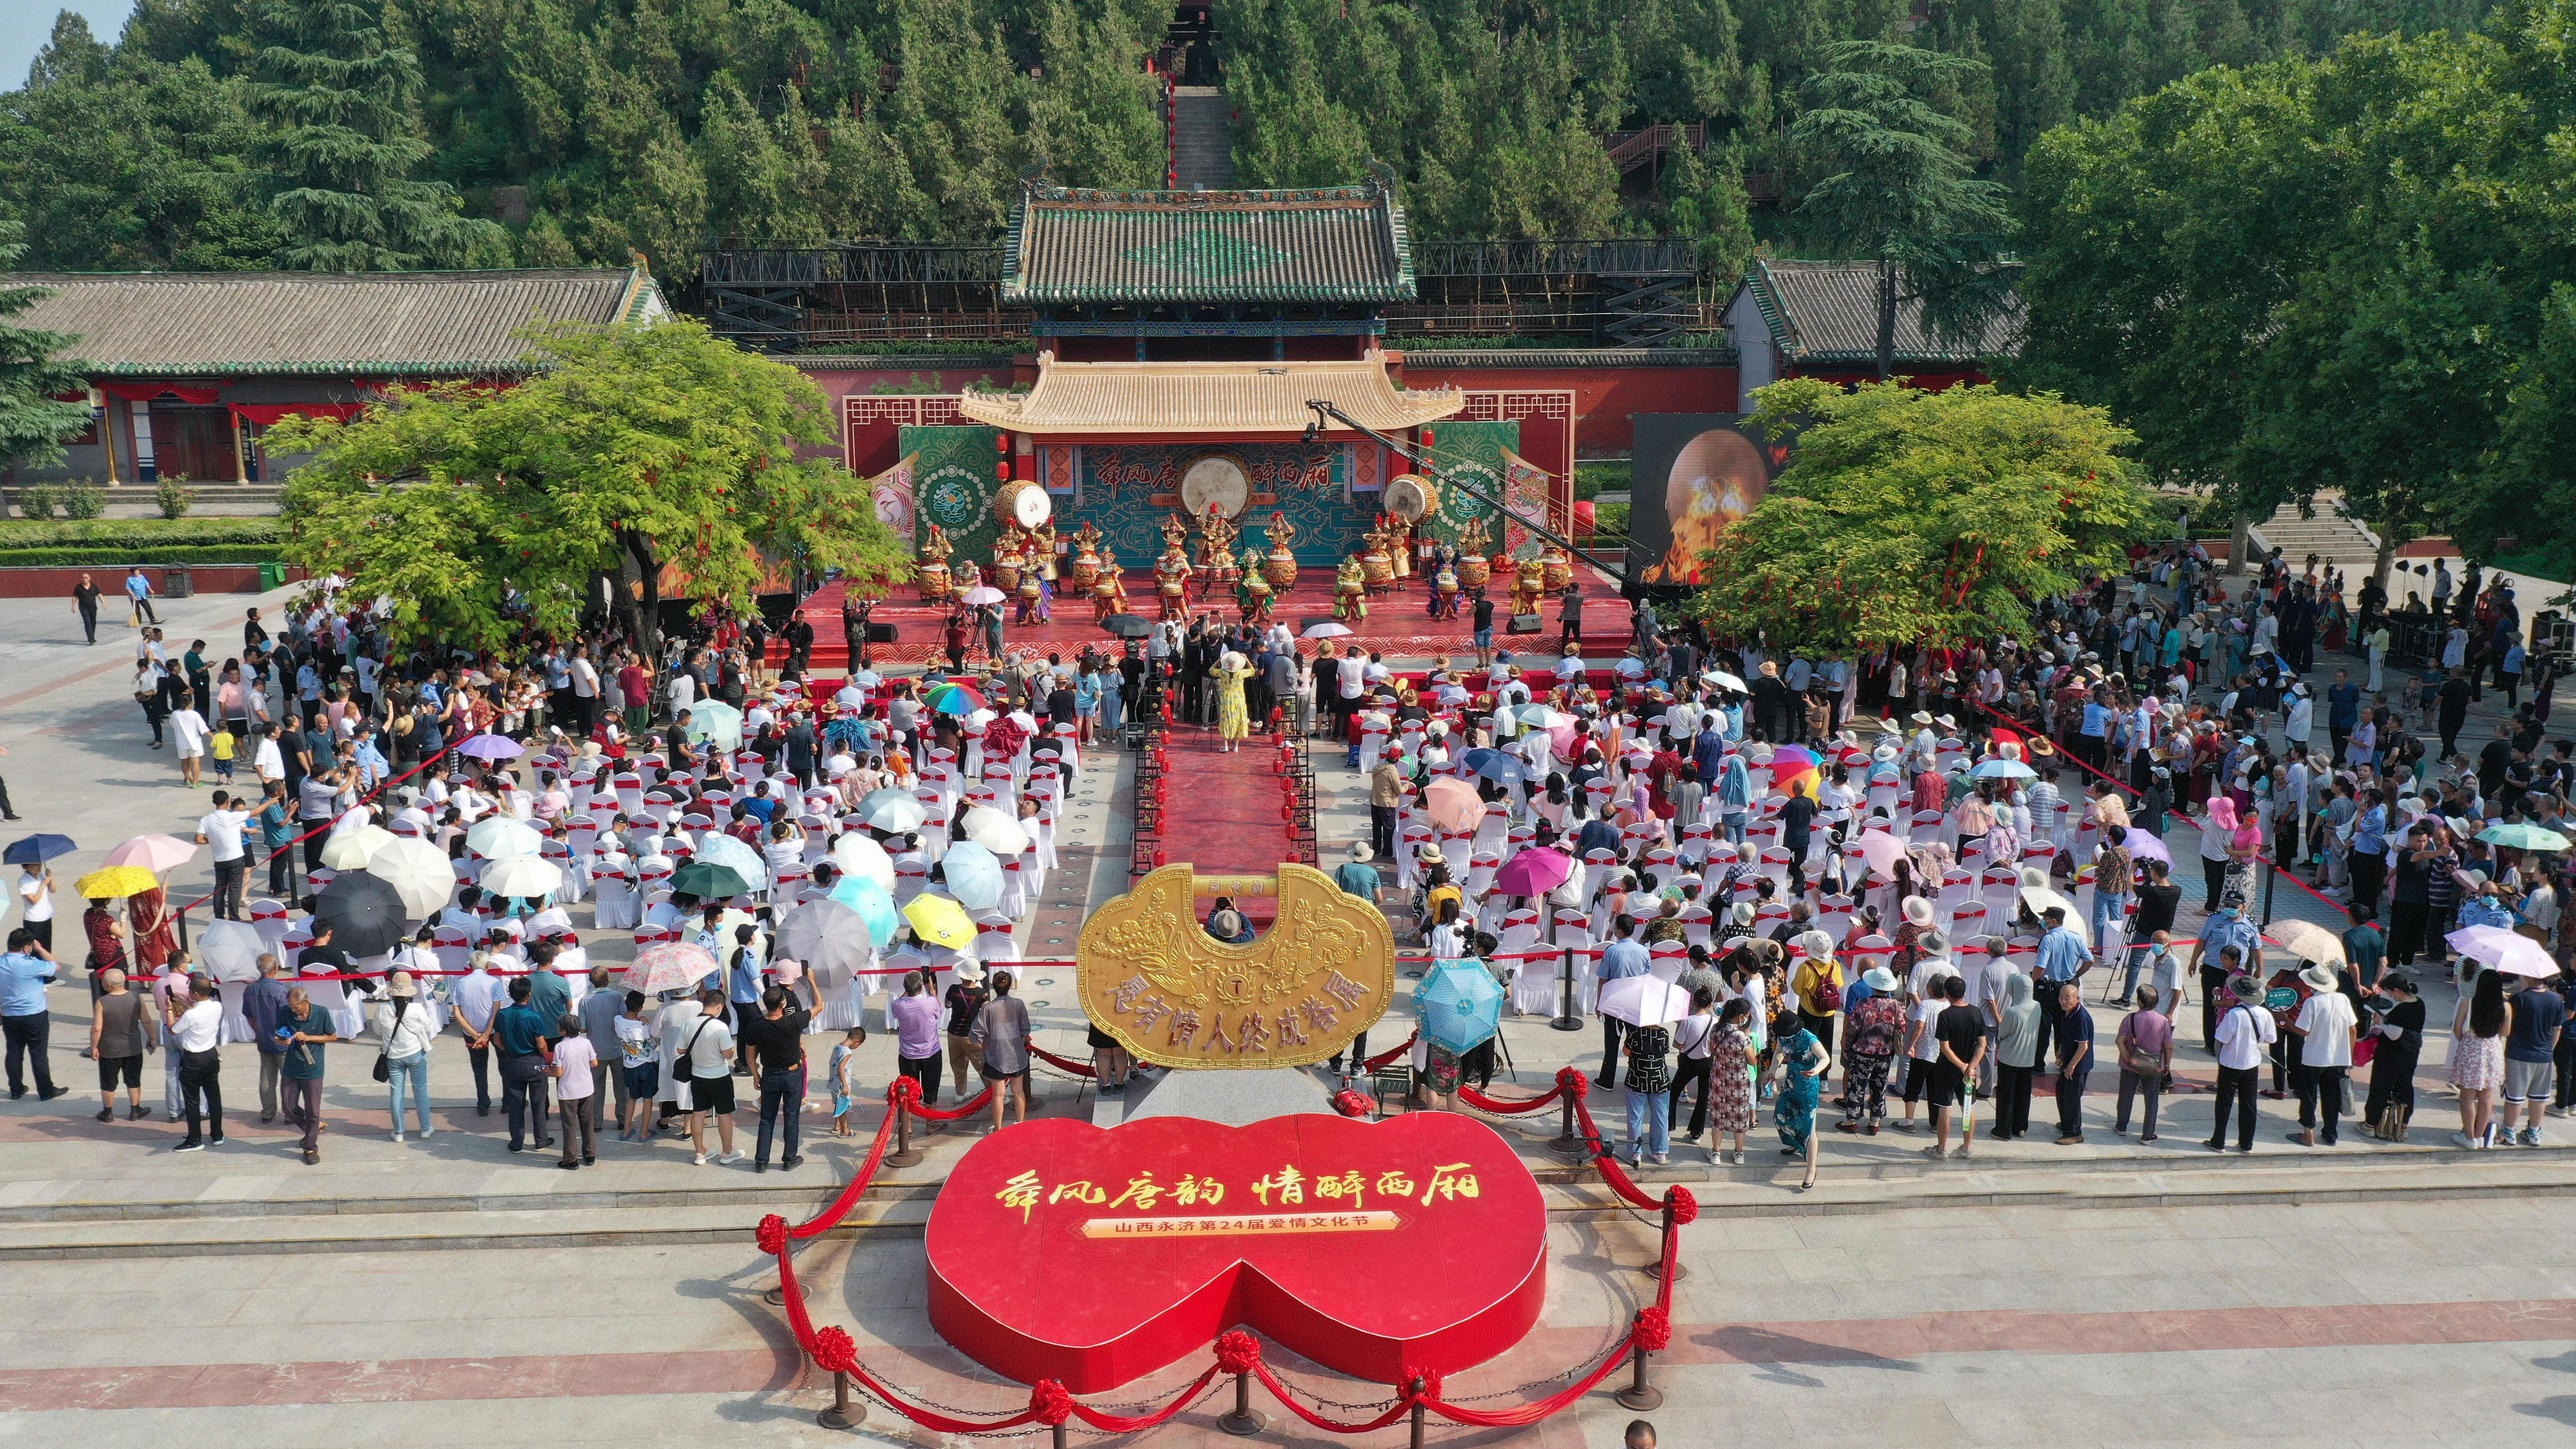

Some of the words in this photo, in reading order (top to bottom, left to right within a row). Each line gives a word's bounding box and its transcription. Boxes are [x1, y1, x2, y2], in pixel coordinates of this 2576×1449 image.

[995, 1168, 1224, 1225] 舜风唐韵
[1251, 1162, 1481, 1208] 情醉西厢
[1115, 1215, 1370, 1235] 山西永济第24届爱情文化节
